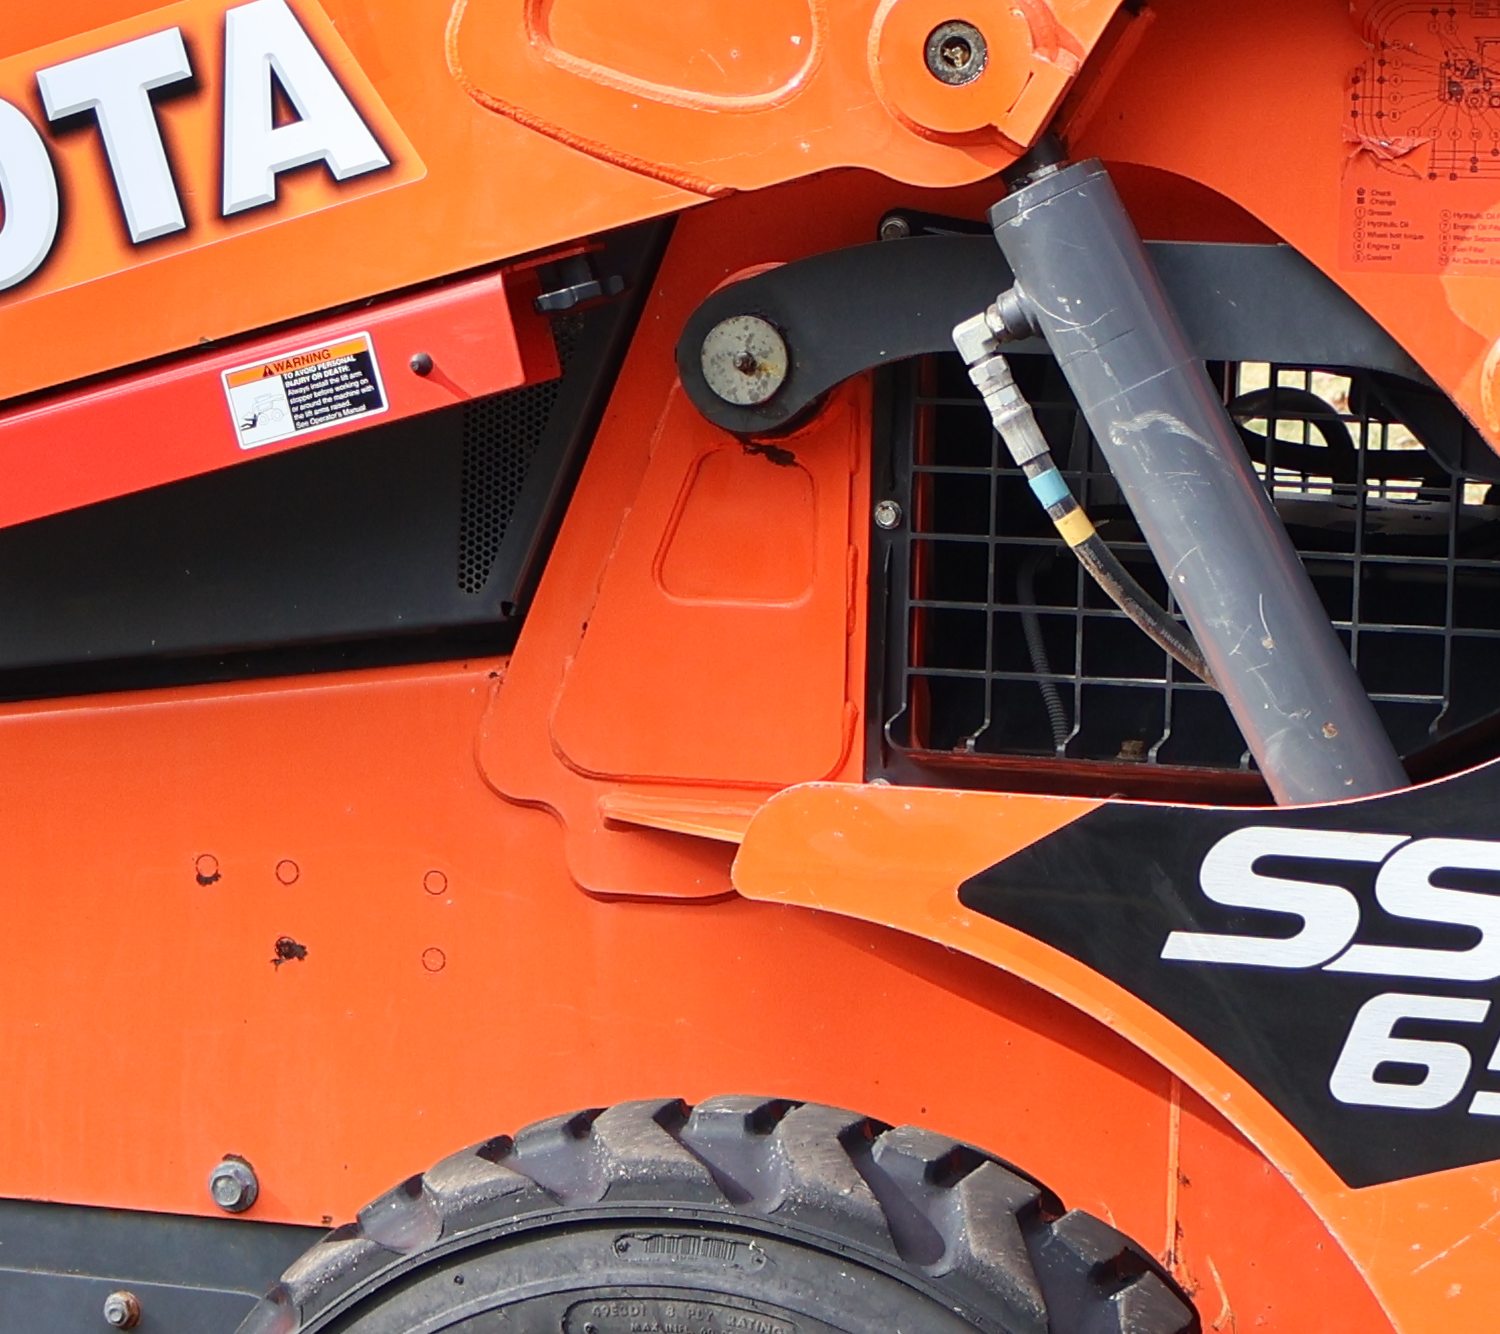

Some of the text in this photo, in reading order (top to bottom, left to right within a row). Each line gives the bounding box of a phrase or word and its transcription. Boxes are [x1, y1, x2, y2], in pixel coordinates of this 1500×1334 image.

[273, 348, 331, 373] WARNING
[282, 355, 356, 380] TO AVOID PERSONAL
[284, 376, 310, 388] INJURY
[311, 373, 322, 381] OR
[287, 385, 310, 397] Always
[310, 380, 328, 390] install
[329, 376, 340, 384] the
[349, 371, 362, 379] arm
[289, 392, 313, 406] stopper
[313, 387, 334, 398] before
[334, 380, 359, 393] working
[299, 399, 321, 410] around
[321, 396, 332, 404] the
[333, 388, 360, 401] machine
[360, 384, 374, 393] with
[293, 412, 304, 420] the
[313, 406, 329, 415] arms
[329, 399, 351, 411] raised.
[295, 404, 366, 428] See Operator's Manual
[631, 1322, 657, 1332] MAX
[687, 1308, 713, 1322] PLY
